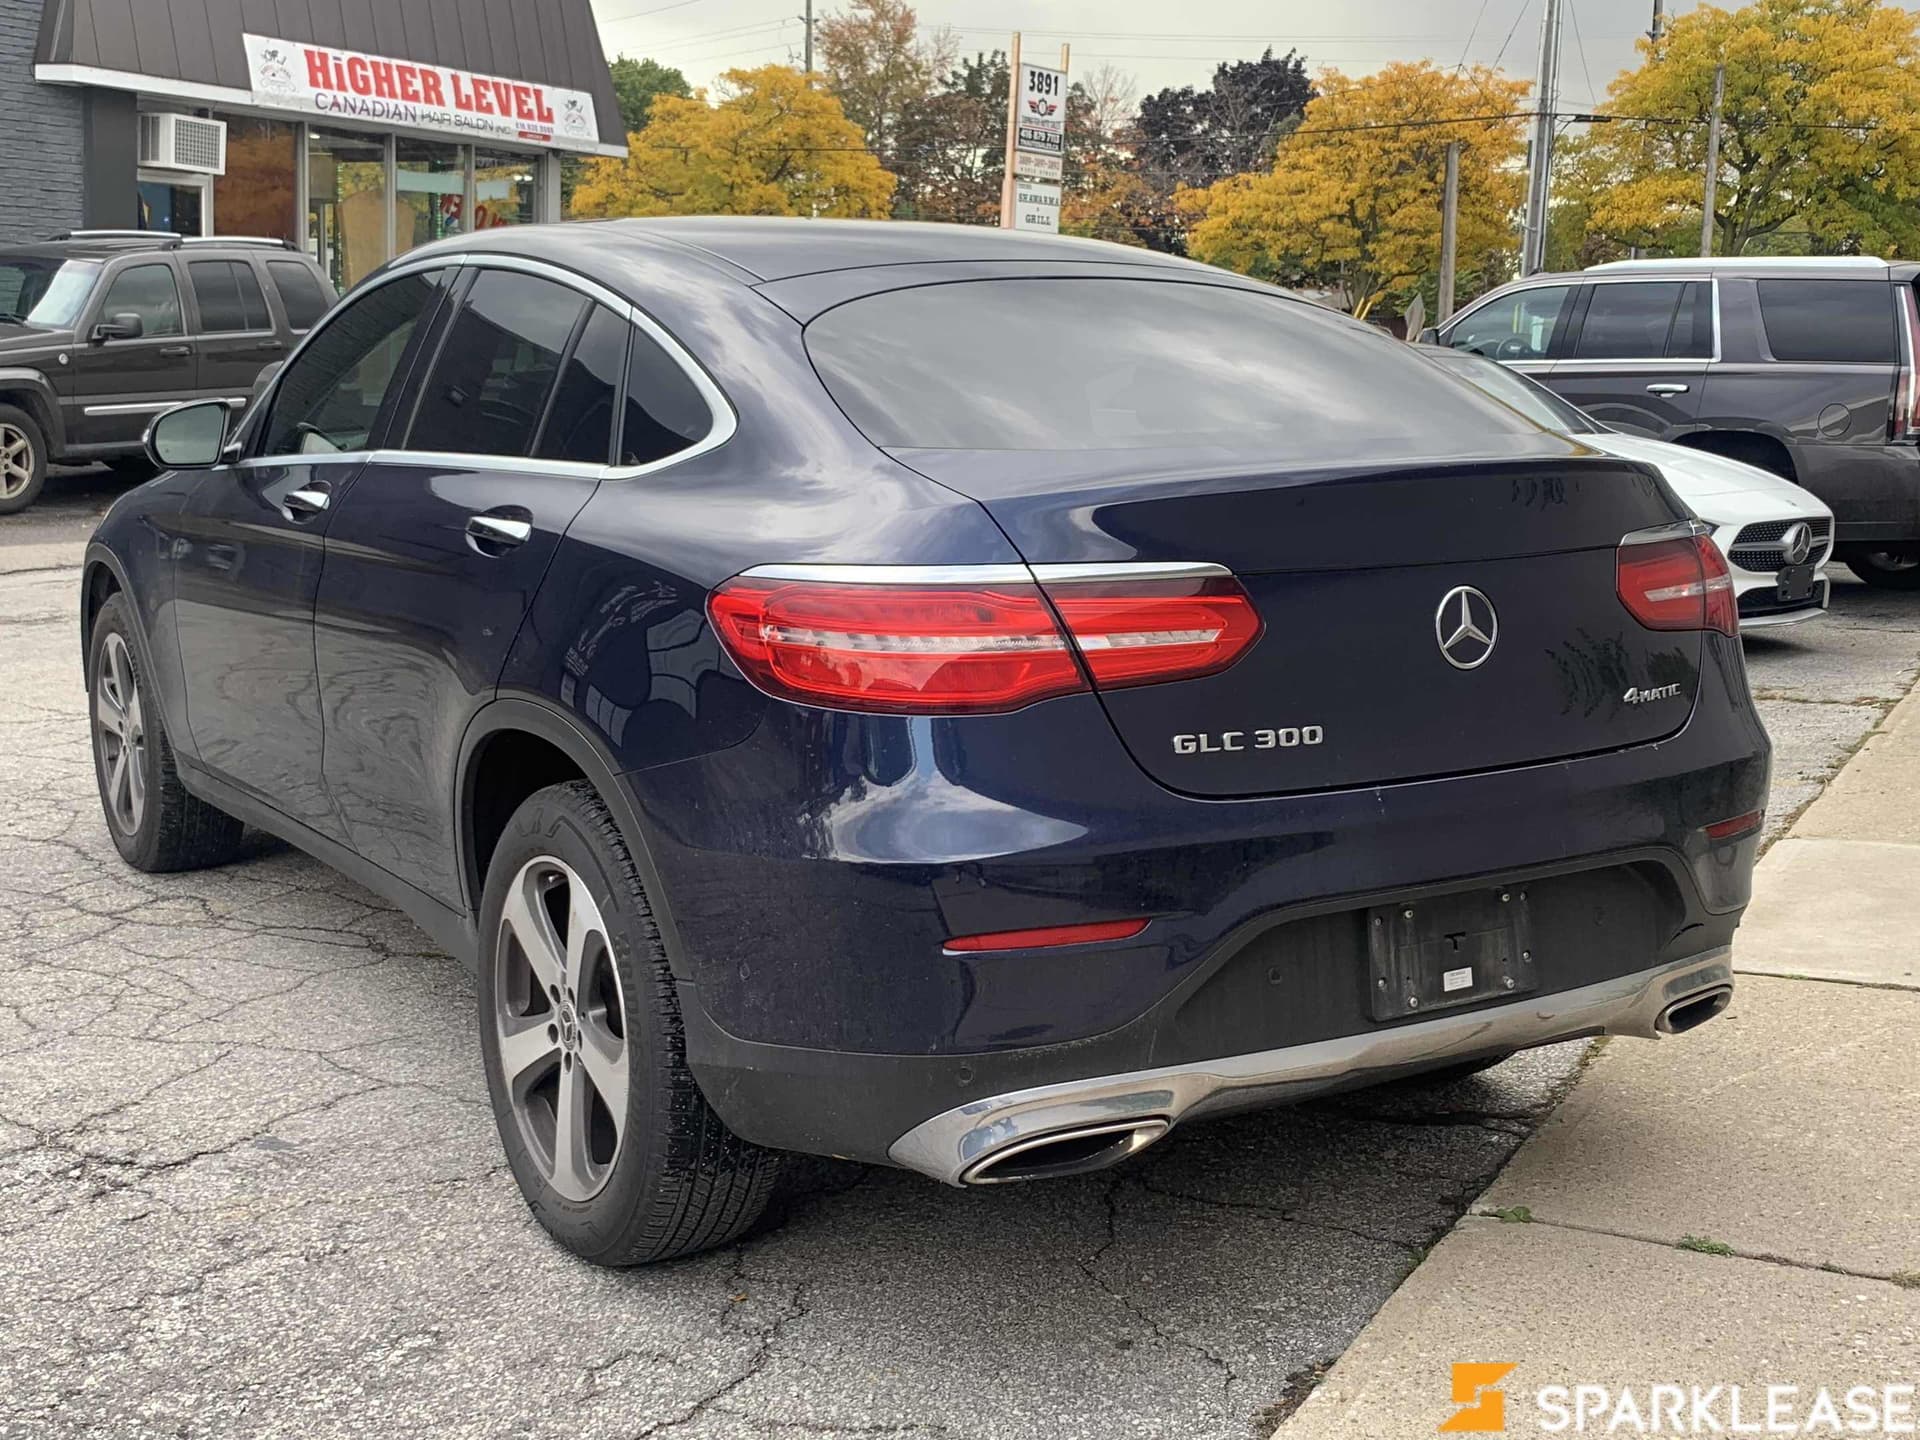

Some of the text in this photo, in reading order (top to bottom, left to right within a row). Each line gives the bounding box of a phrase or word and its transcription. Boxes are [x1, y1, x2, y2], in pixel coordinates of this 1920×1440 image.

[1029, 70, 1058, 96] 3891
[315, 92, 417, 123] CANADIAN
[421, 109, 451, 126] HAIR
[454, 115, 494, 131] SALON
[451, 73, 554, 123] LEVEL
[1025, 213, 1051, 226] GRILL
[1623, 683, 1681, 705] 4MATIC
[1173, 725, 1324, 754] GLC 300
